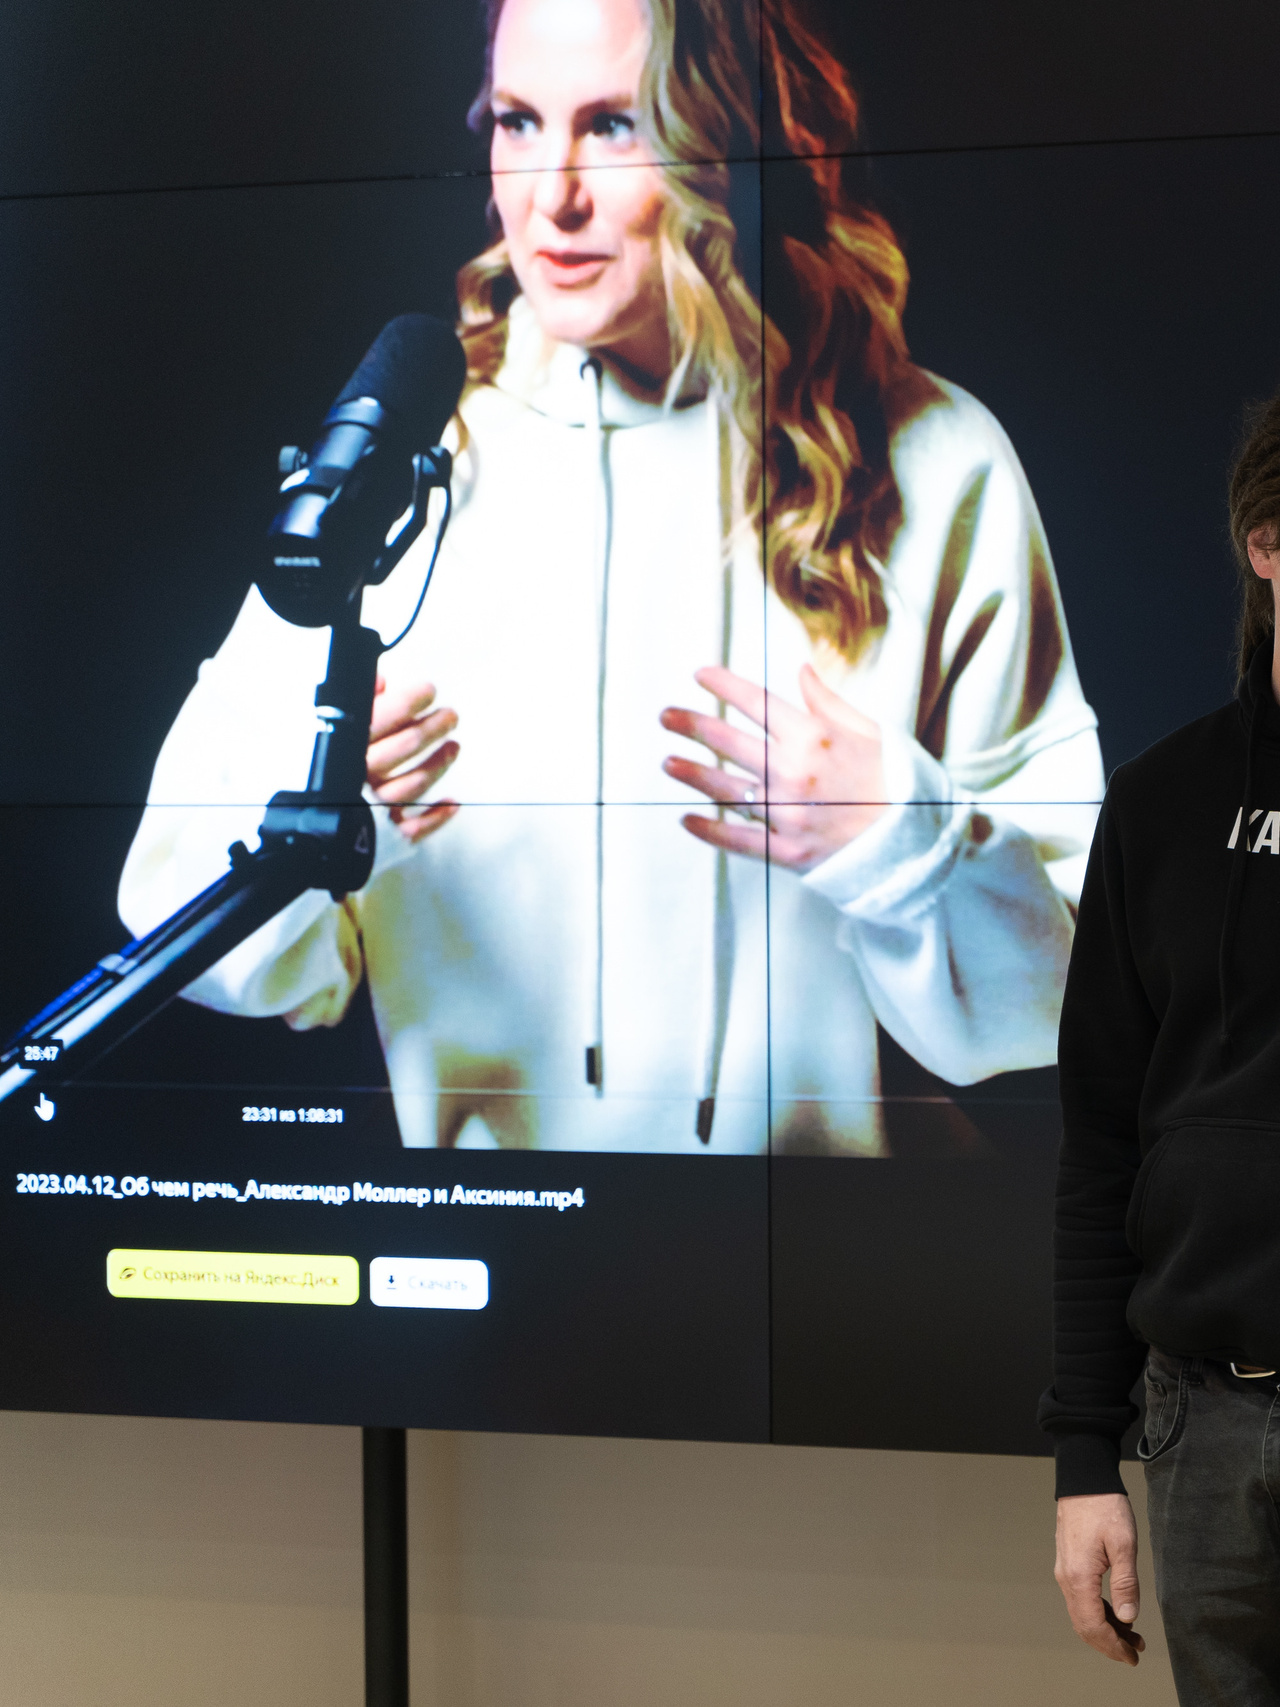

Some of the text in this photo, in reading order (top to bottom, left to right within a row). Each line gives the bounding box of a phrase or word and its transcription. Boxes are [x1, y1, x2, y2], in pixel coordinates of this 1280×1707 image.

[242, 1106, 278, 1122] 23:31
[280, 1109, 297, 1122] из
[16, 1173, 585, 1211] 2023.04.12_Об чем речь_Александр Моллер и Аксиния.mp4
[143, 1266, 220, 1284] Сохранить
[226, 1272, 241, 1284] на
